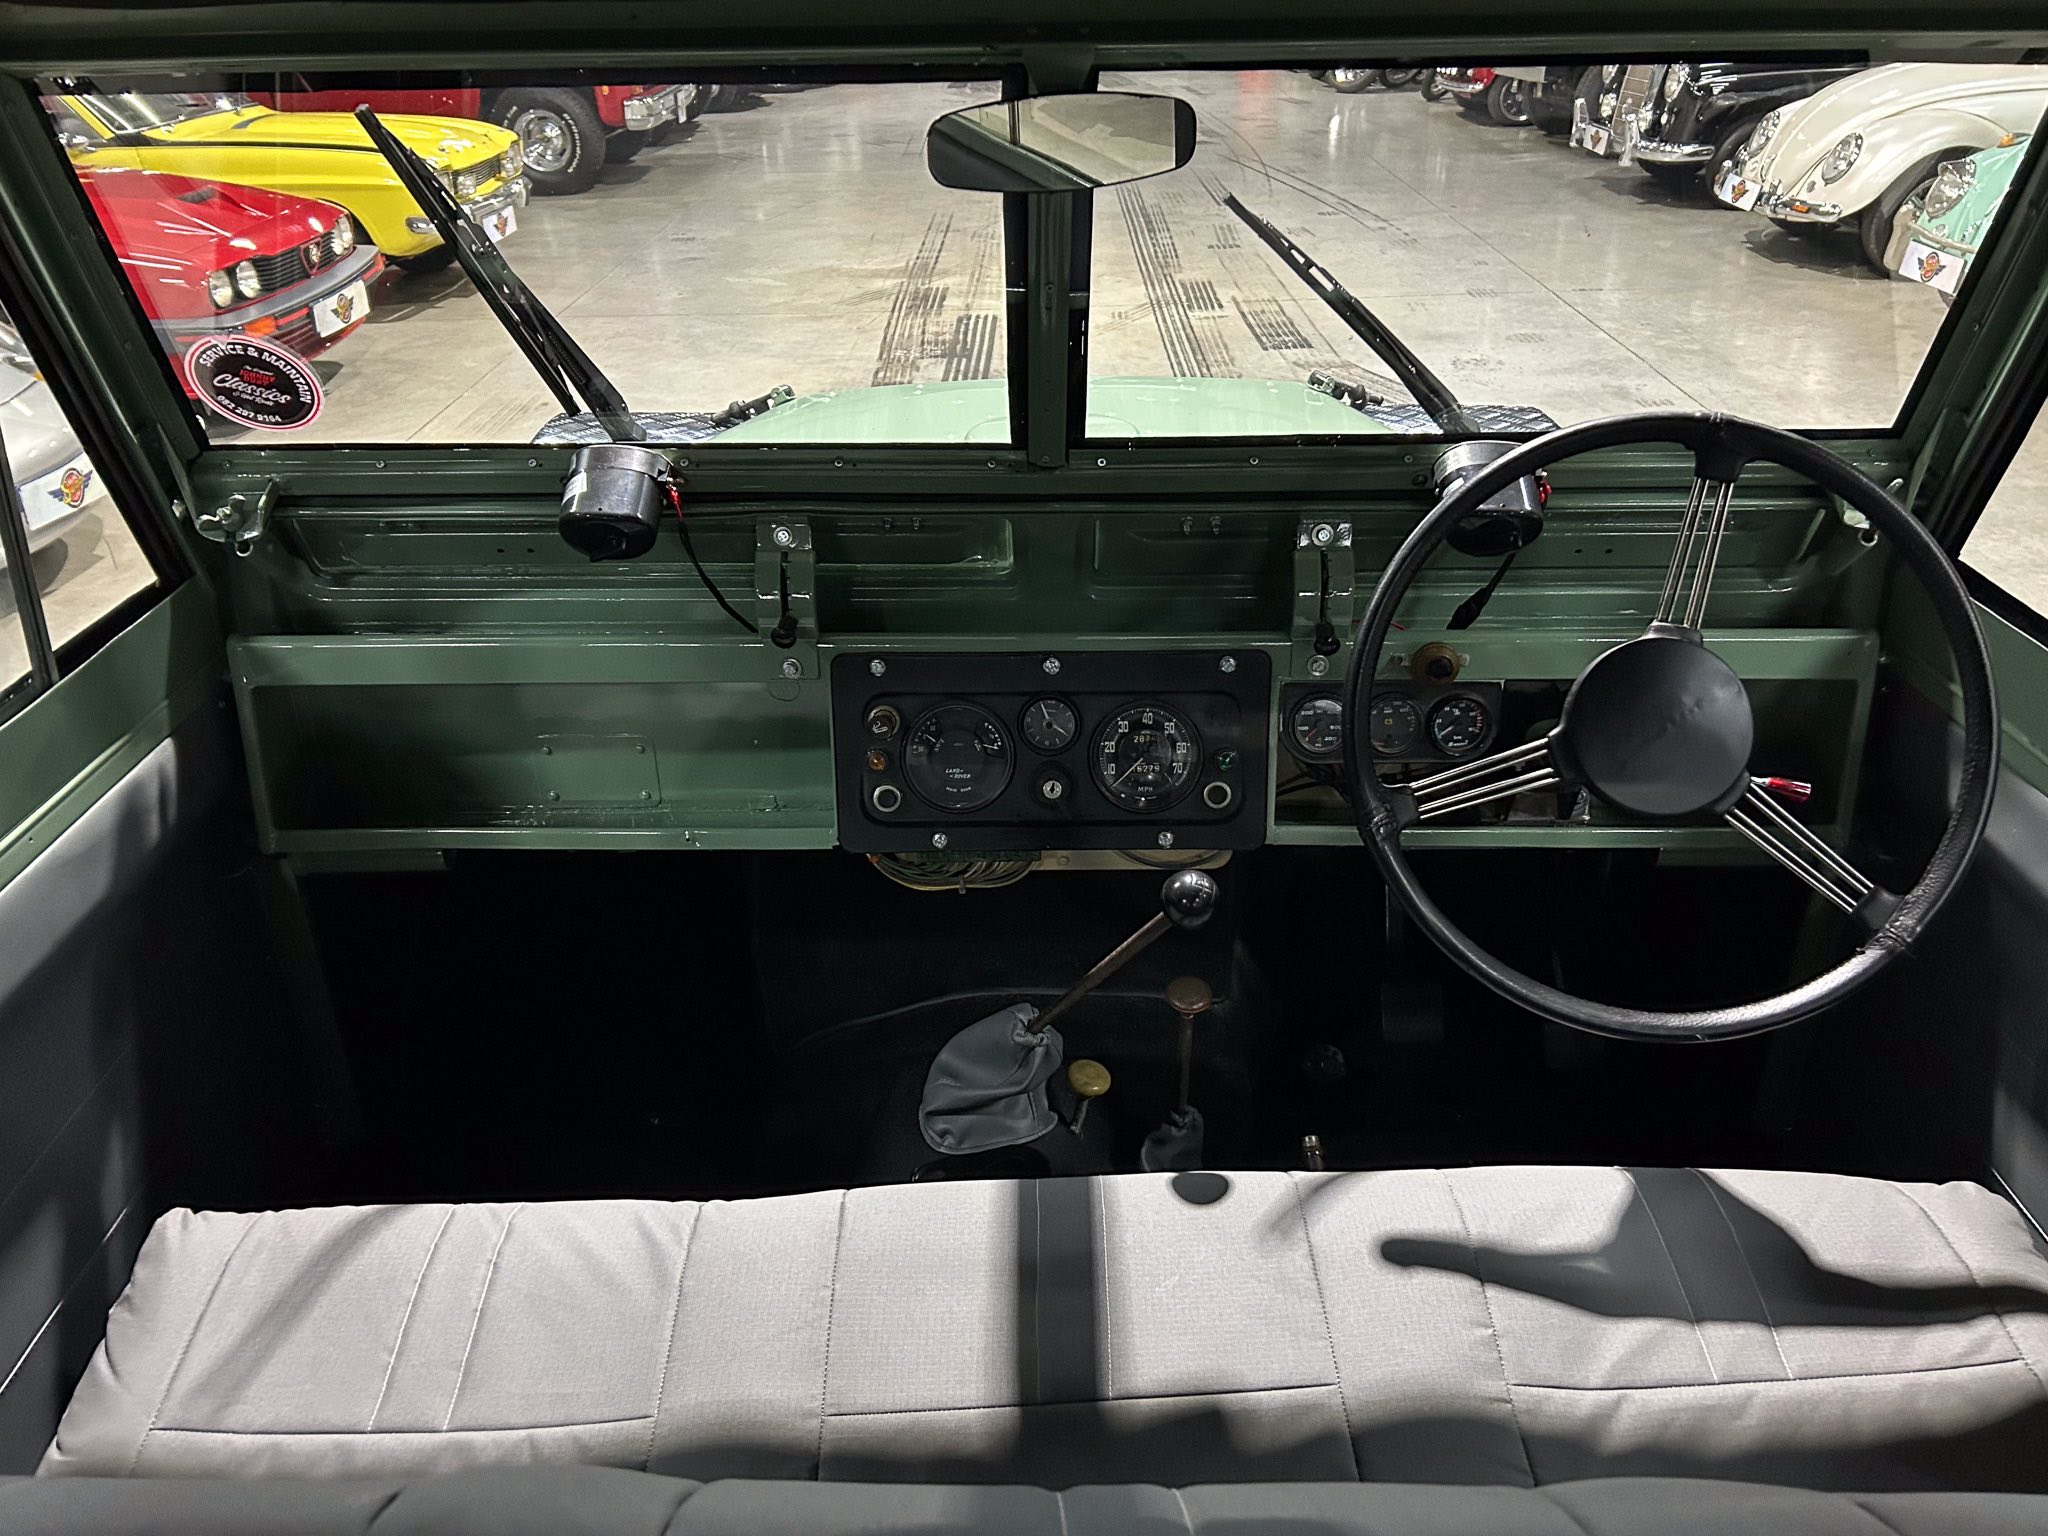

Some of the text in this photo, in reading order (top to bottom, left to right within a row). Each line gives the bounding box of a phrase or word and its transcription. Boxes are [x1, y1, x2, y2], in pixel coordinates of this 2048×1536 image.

[198, 344, 312, 404] SERVICE & MAINTAIN
[212, 373, 292, 404] Classics
[217, 395, 235, 410] 082
[1141, 712, 1153, 724] 40
[1117, 720, 1129, 733] 30
[1163, 722, 1175, 734] 50
[1104, 741, 1116, 753] 20
[1175, 742, 1187, 753] 60
[1107, 763, 1116, 774] 10
[1172, 762, 1183, 774] 70
